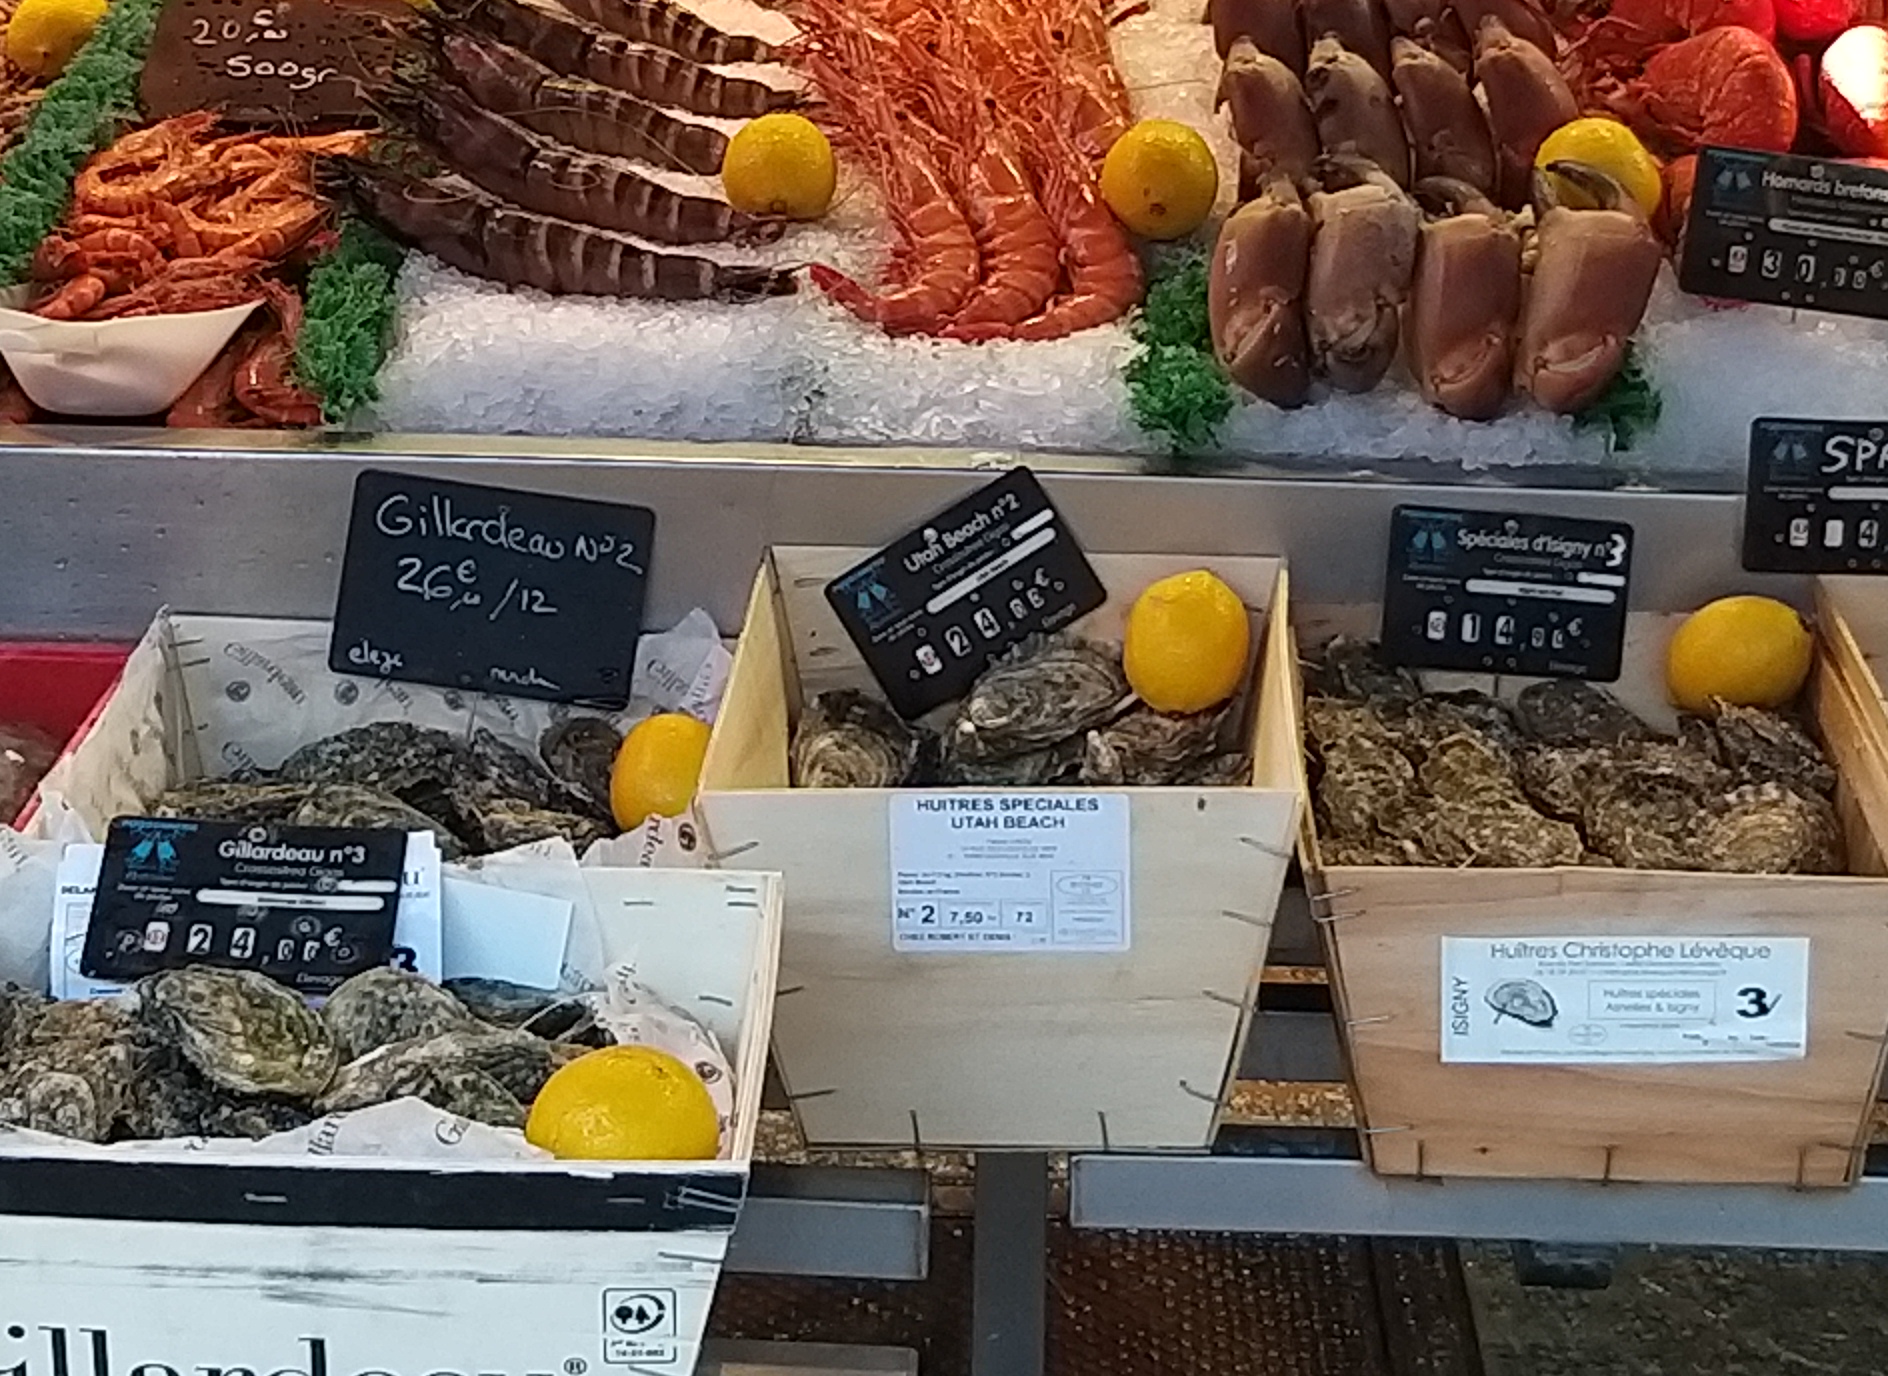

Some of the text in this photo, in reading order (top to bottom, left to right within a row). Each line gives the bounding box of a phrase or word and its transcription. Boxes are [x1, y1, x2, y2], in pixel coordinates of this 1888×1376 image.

[1761, 170, 1831, 195] Homards
[903, 534, 945, 575] Utah
[941, 508, 992, 553] Beach
[1457, 528, 1529, 551] Spéciales
[1531, 532, 1591, 560] d'Isigny
[916, 797, 1099, 812] HUITRES SPECIALES
[950, 815, 1066, 829] UTAH BEACH
[218, 839, 367, 865] Gillardeau n°3
[920, 905, 936, 925] 2
[1490, 940, 1772, 964] Huîtres Christophe Lévêque
[1451, 975, 1470, 1036] ISIGNY
[1735, 986, 1771, 1019] 3
